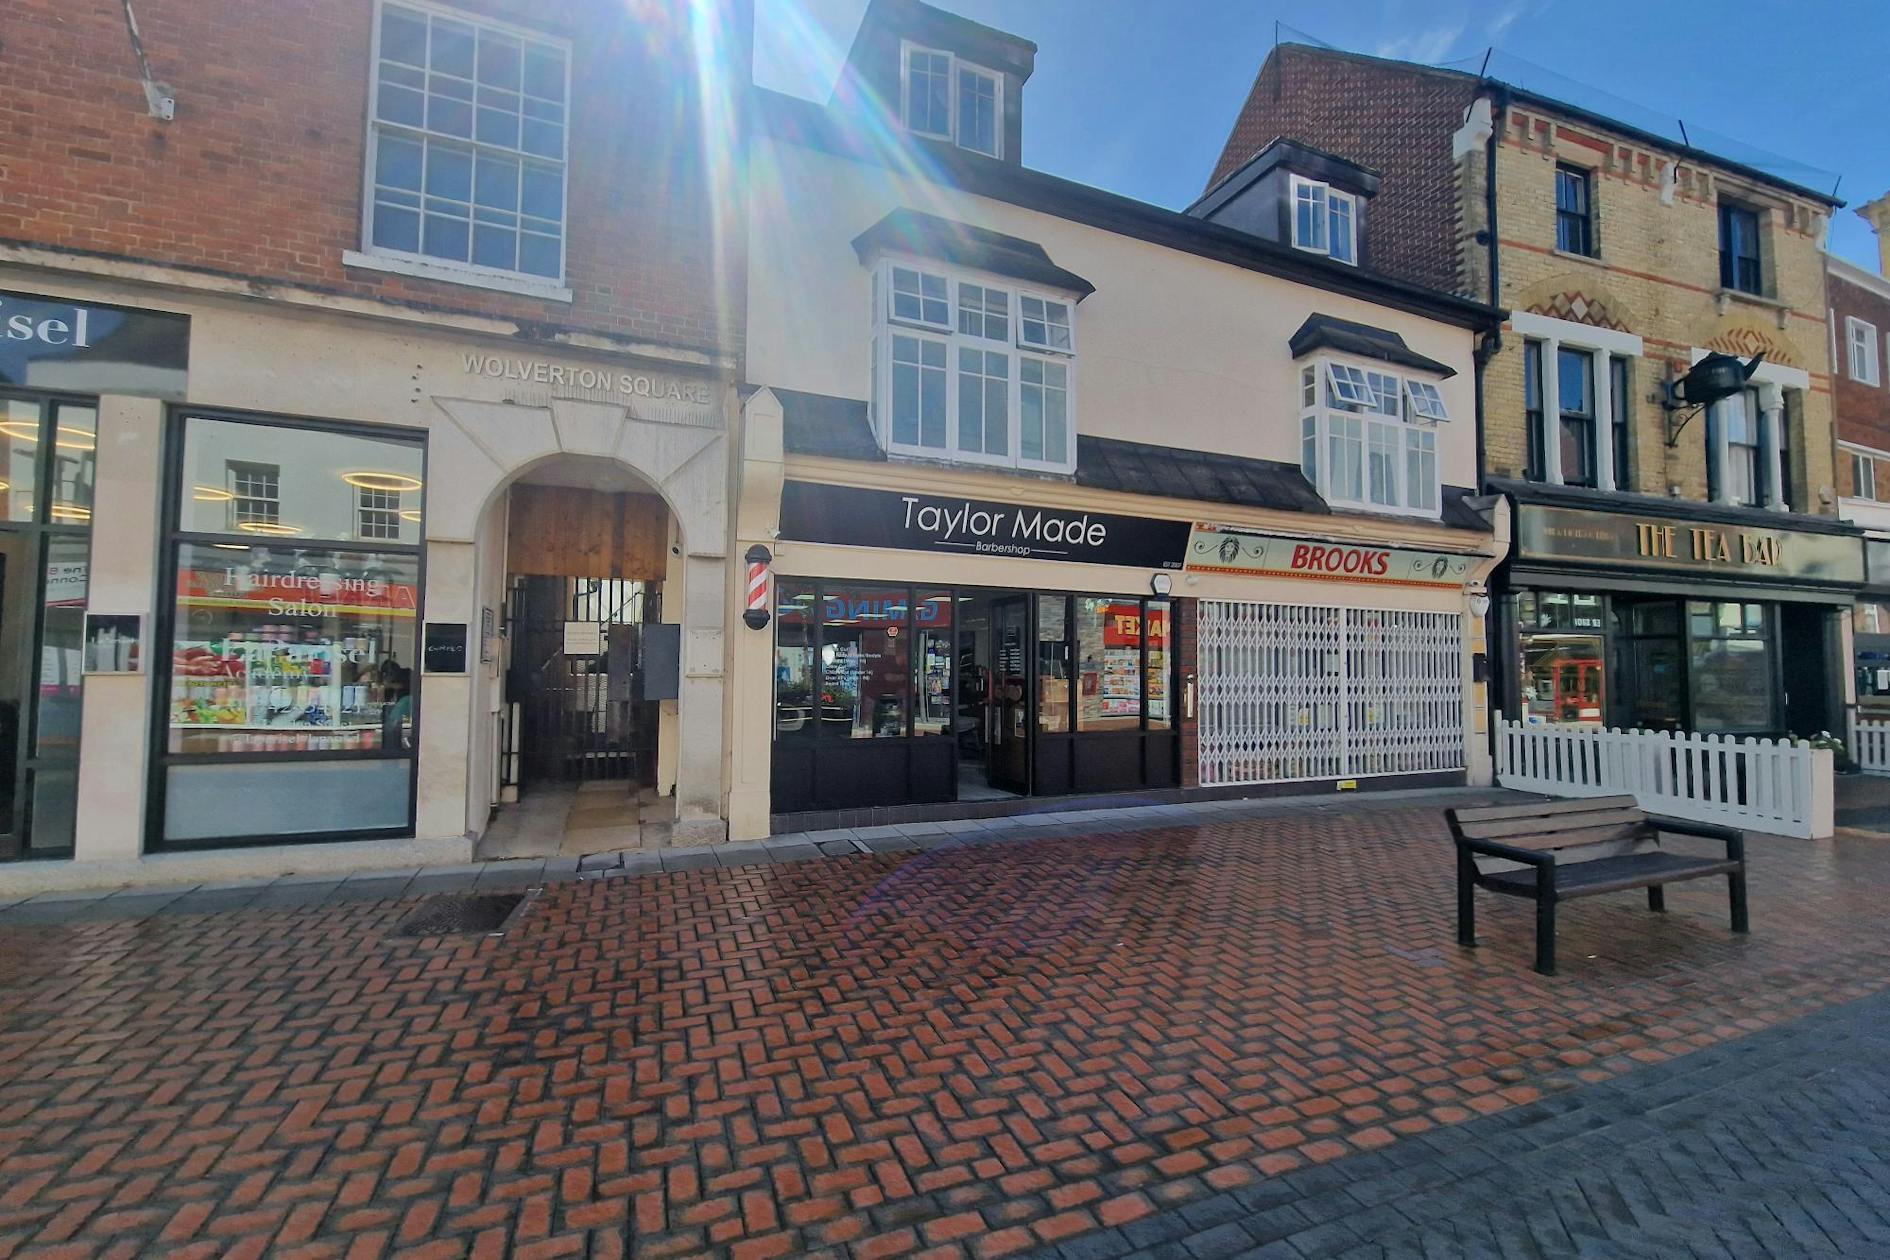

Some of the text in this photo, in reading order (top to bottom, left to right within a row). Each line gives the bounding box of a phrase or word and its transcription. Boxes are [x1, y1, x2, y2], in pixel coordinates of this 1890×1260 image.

[462, 354, 712, 404] WOLVERTON SQUARE
[902, 497, 1107, 546] Taylor Made
[975, 541, 1030, 556] Barbershop
[1291, 544, 1391, 575] BROOKS
[1636, 523, 1678, 559] THE
[1689, 528, 1731, 562] TEA
[267, 597, 338, 618] Salon
